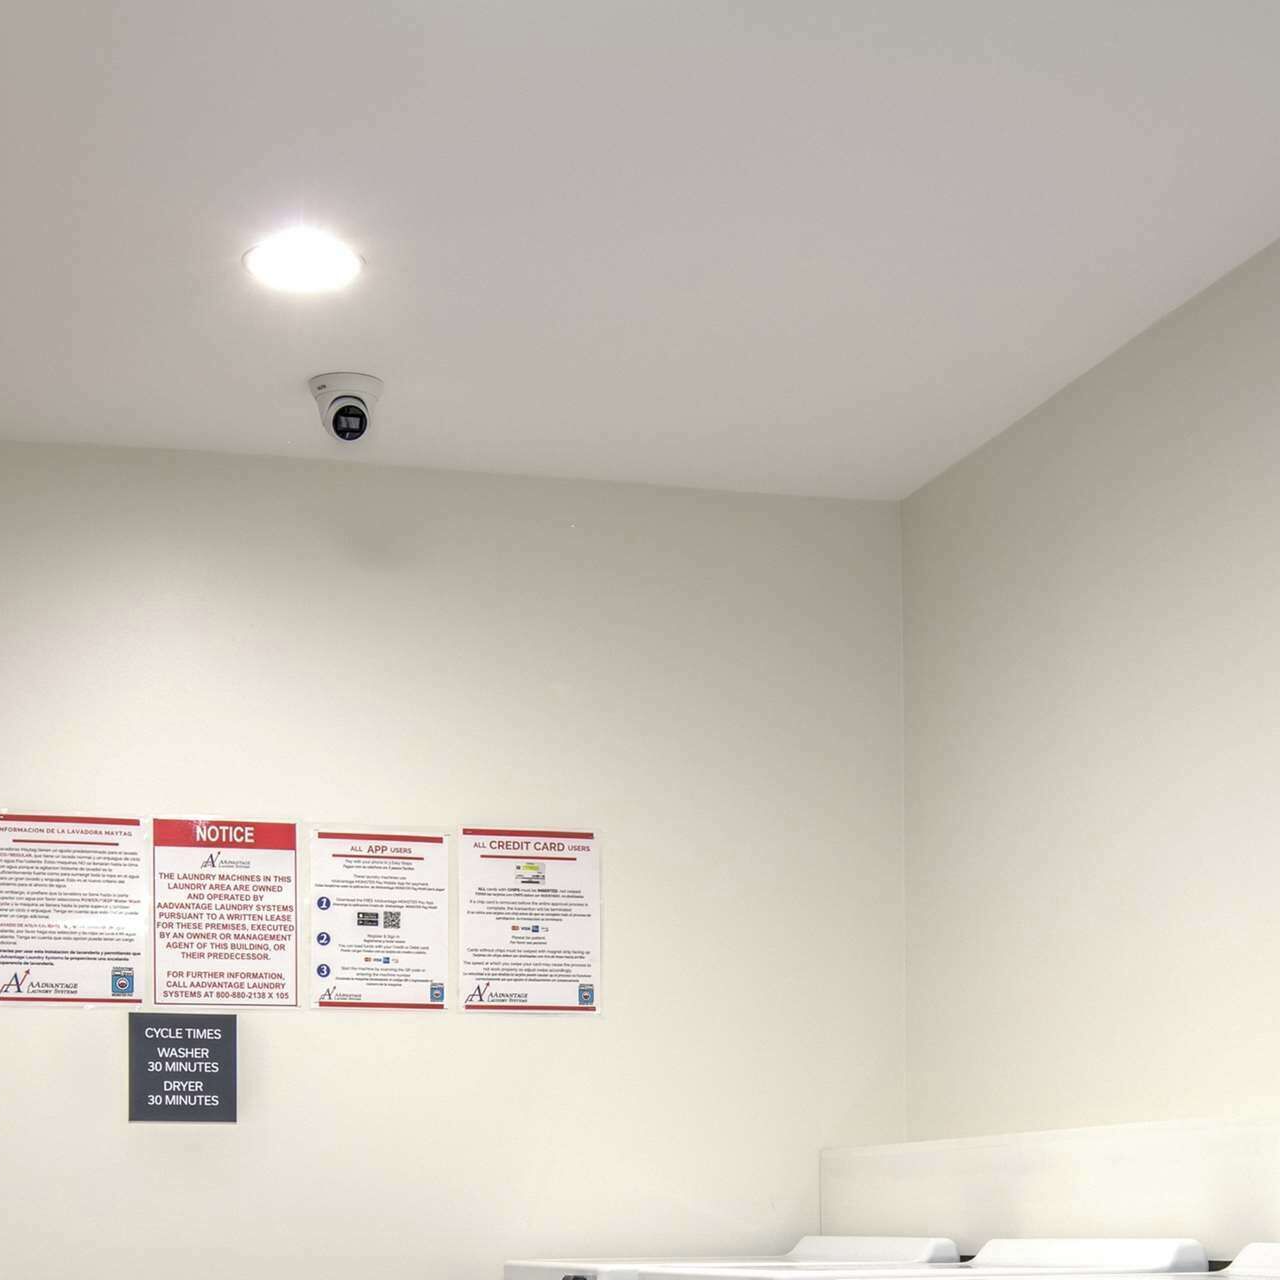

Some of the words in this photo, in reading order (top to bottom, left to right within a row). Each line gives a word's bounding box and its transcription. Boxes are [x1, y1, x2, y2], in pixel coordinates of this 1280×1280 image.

[196, 826, 255, 842] NOTICE
[368, 845, 388, 854] APP
[490, 841, 530, 850] CREDIT
[534, 842, 564, 852] CARD
[158, 872, 174, 880] THE
[206, 893, 250, 901] OPERATED
[157, 902, 212, 910] AADVANTAGE
[205, 923, 248, 931] PREMISES,
[230, 944, 271, 952] BUILDING,
[226, 972, 285, 980] INFORMATION,
[145, 1028, 182, 1038] CYCLE
[185, 1028, 222, 1040] TIMES
[157, 1048, 210, 1058] WASHER
[148, 1062, 162, 1072] 30
[165, 1062, 219, 1072] MINUTES
[164, 1080, 204, 1092] DRYER
[148, 1095, 162, 1105] 30
[165, 1095, 220, 1106] MINUTES
